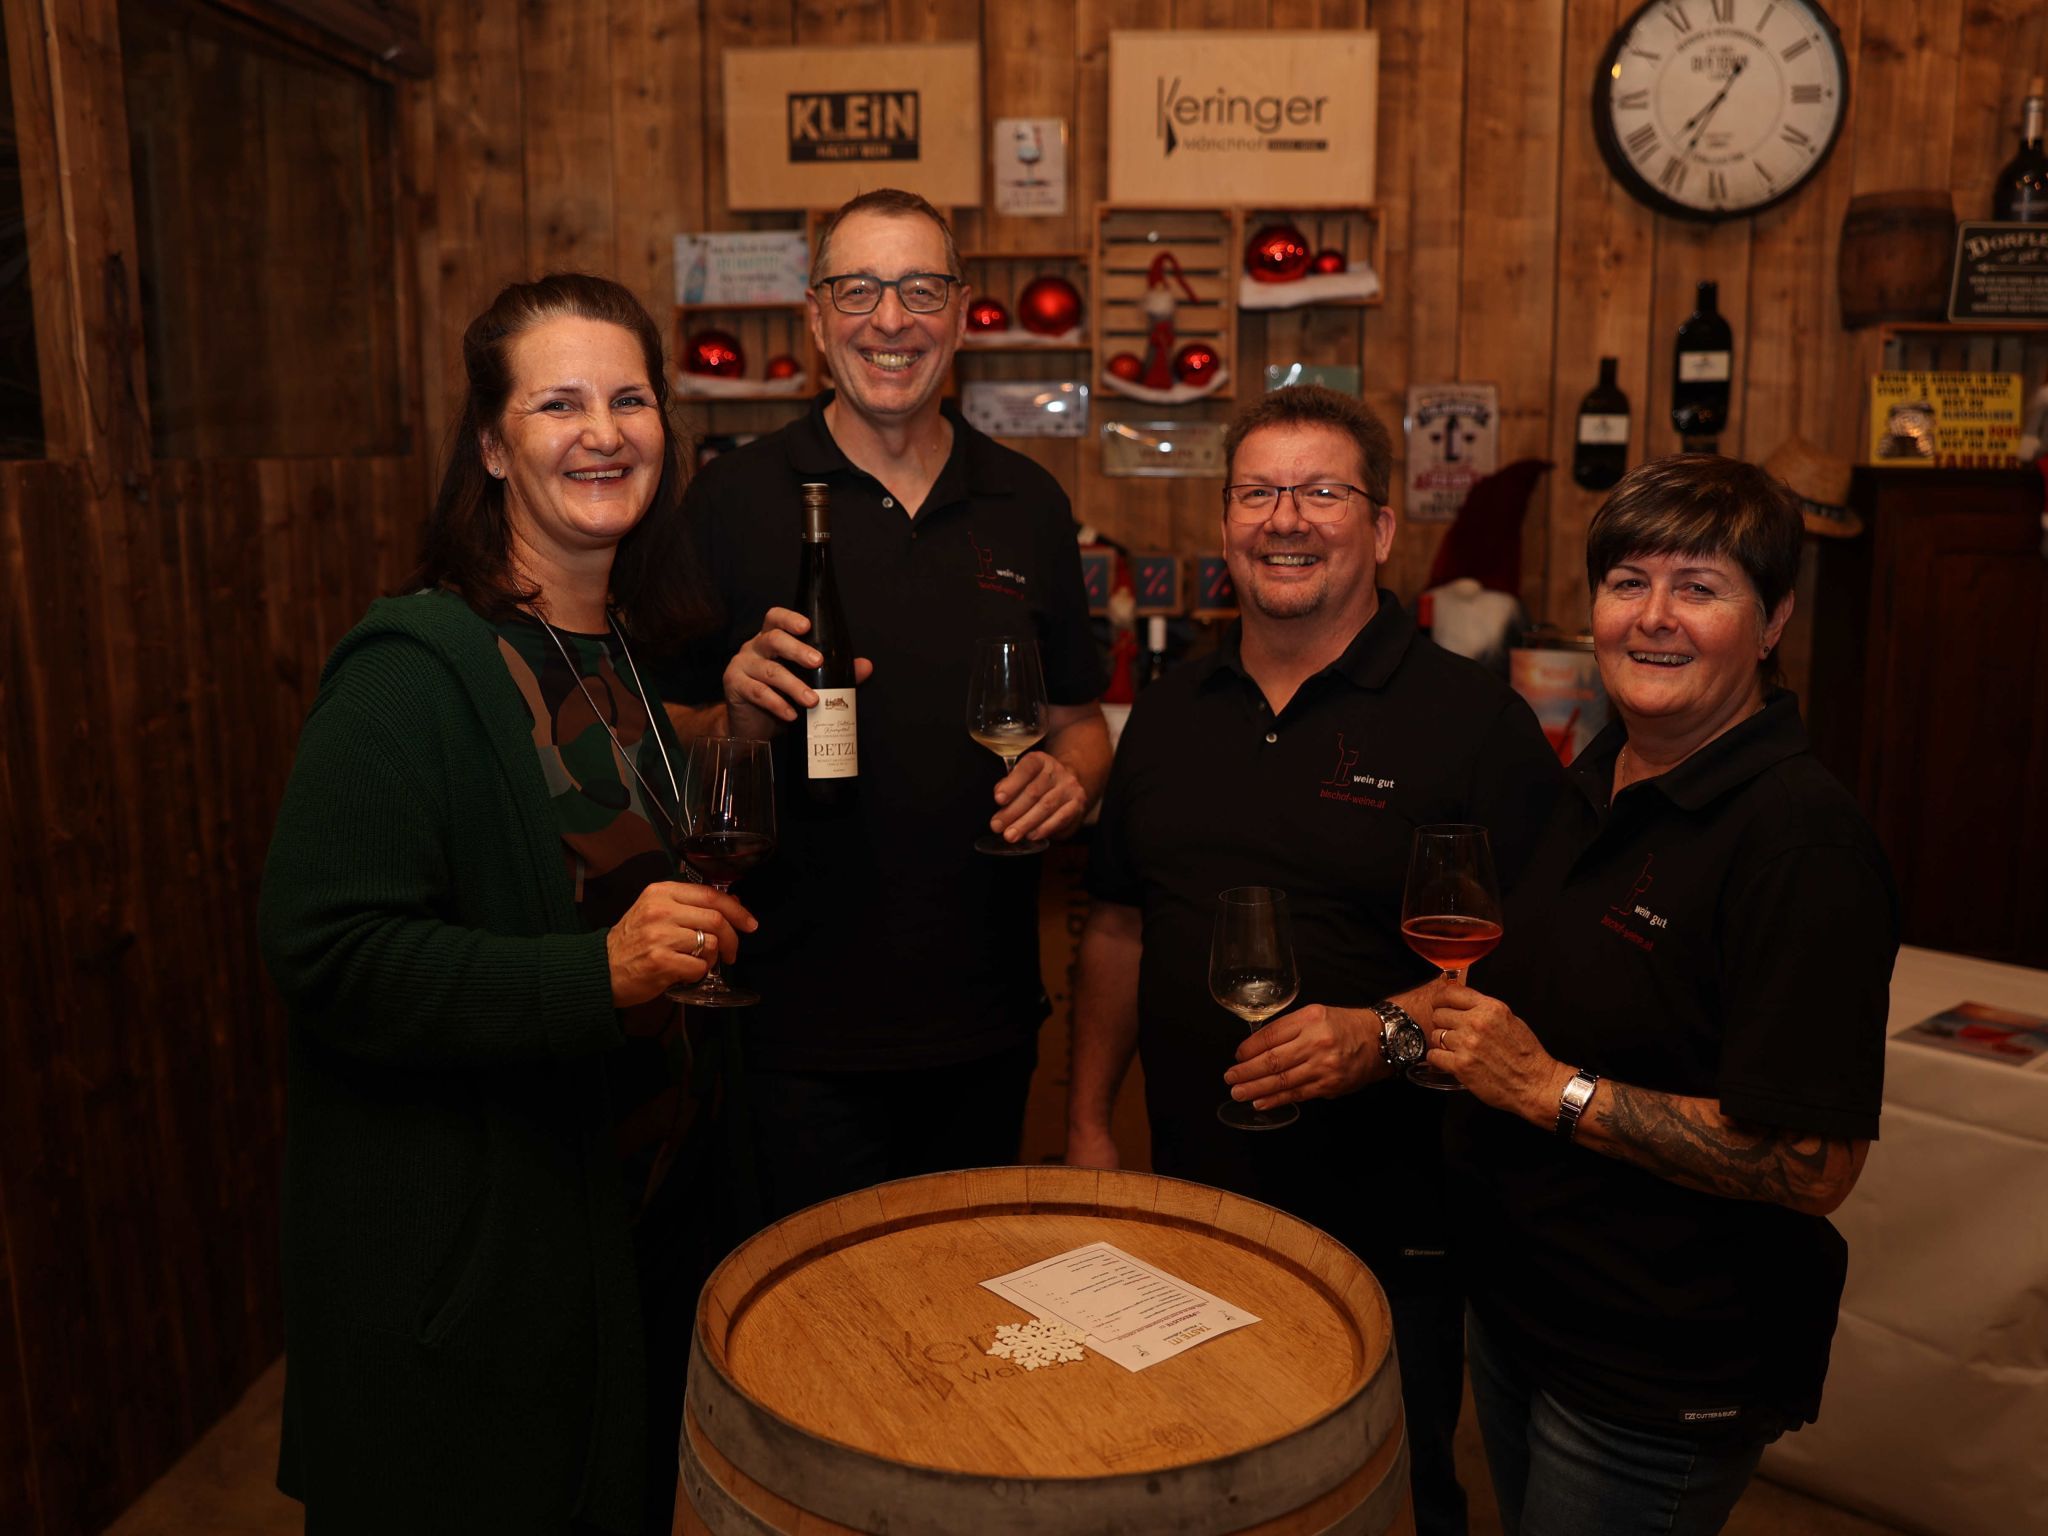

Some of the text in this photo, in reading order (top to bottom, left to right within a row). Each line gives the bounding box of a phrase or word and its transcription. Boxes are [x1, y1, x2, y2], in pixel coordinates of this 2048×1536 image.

[1157, 76, 1329, 142] Keringer
[1353, 775, 1395, 789] wein gut
[1634, 904, 1668, 929] wein gut
